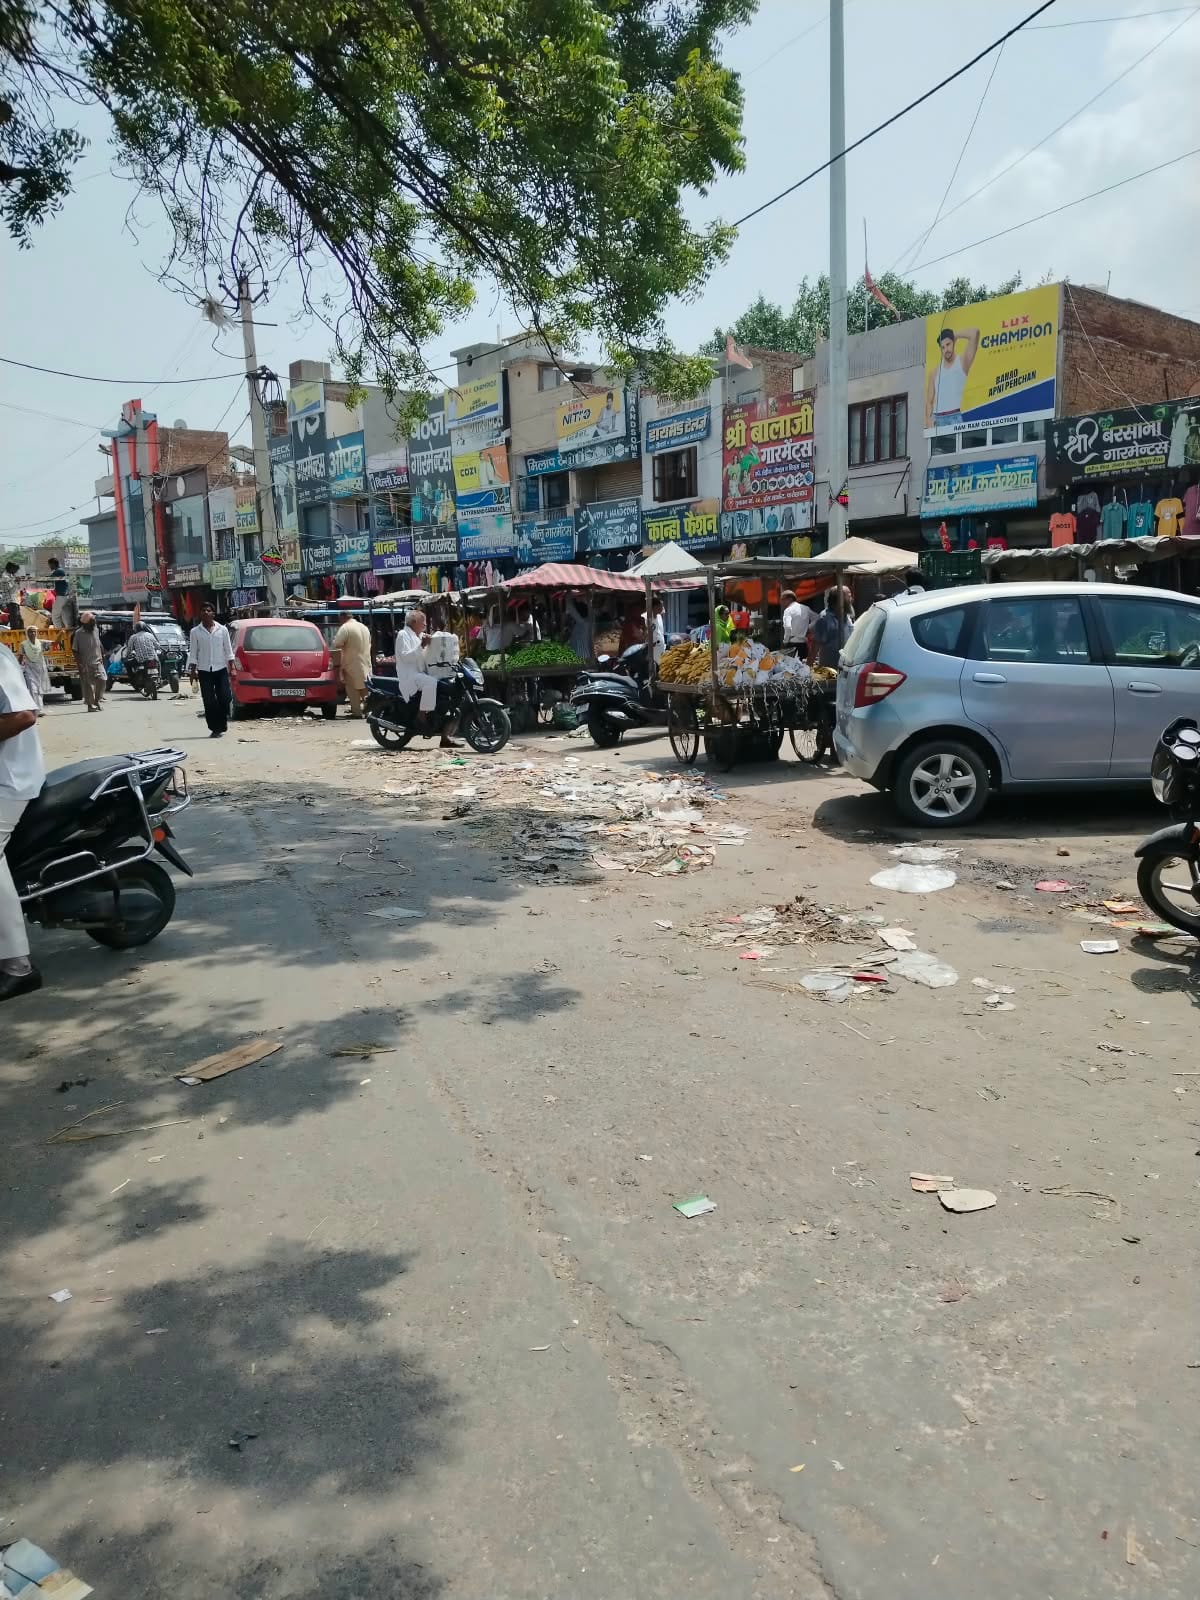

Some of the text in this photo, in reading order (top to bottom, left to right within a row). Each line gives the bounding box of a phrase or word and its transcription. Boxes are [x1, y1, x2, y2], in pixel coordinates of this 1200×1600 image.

[1001, 315, 1030, 328] LUX
[981, 322, 1053, 349] CHAMPION
[988, 370, 1036, 397] APNI PEHCHAN
[995, 369, 1018, 385] BANAO
[629, 396, 639, 459] HANDSOME
[726, 419, 747, 450] श्री
[750, 403, 814, 443] बालाजी
[981, 416, 1018, 427] COLLECTION
[760, 439, 813, 465] गारमेंट्स
[1063, 417, 1100, 465] श्री
[1103, 420, 1162, 444] बरसाना
[460, 467, 477, 478] COZI
